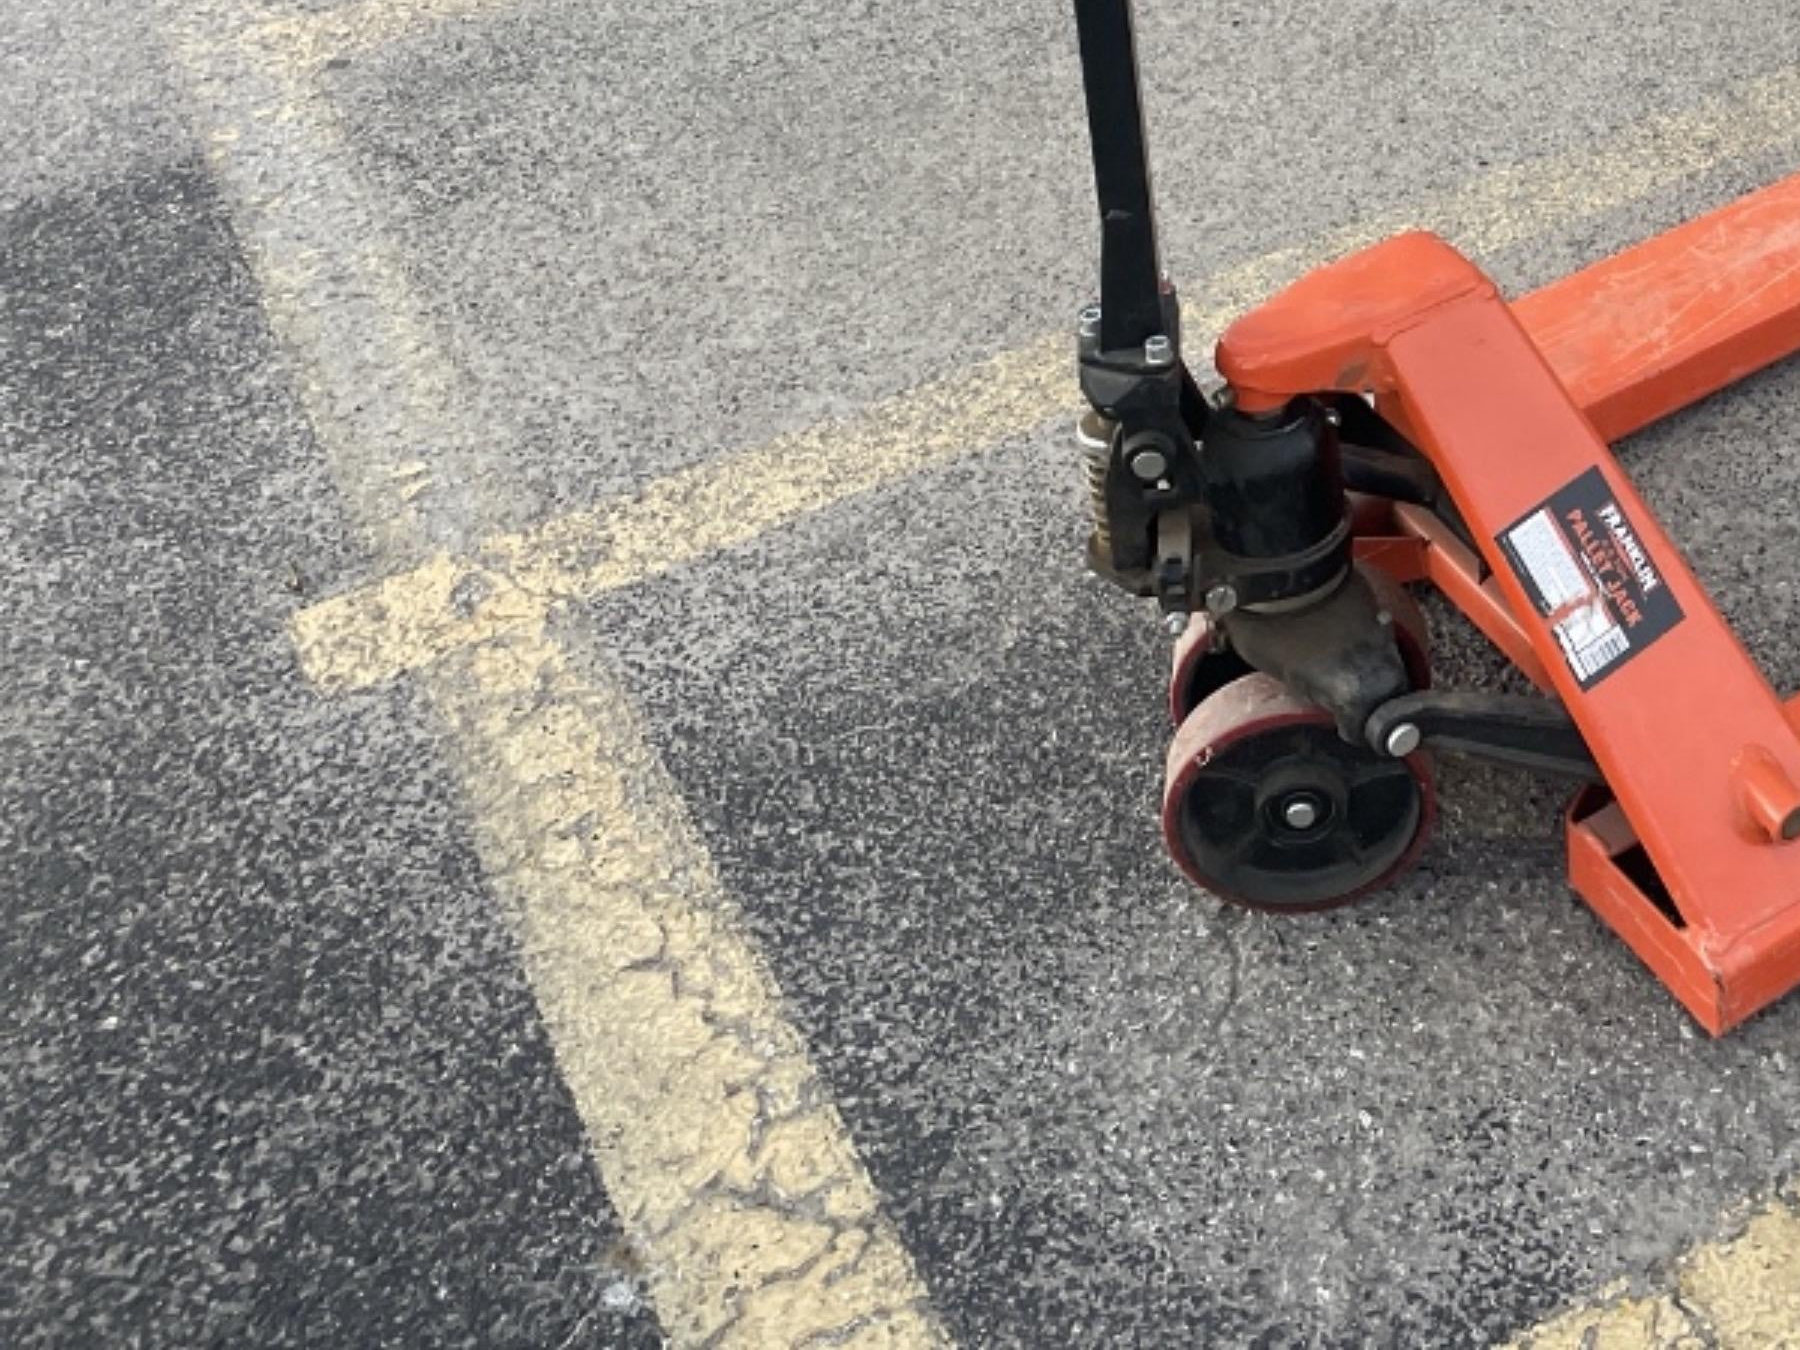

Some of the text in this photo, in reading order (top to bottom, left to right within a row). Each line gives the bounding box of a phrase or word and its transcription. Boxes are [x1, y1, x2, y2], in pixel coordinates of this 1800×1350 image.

[1566, 508, 1614, 573] PALLET
[1606, 578, 1643, 628] JACK
[1599, 502, 1658, 592] FRANKLIN
